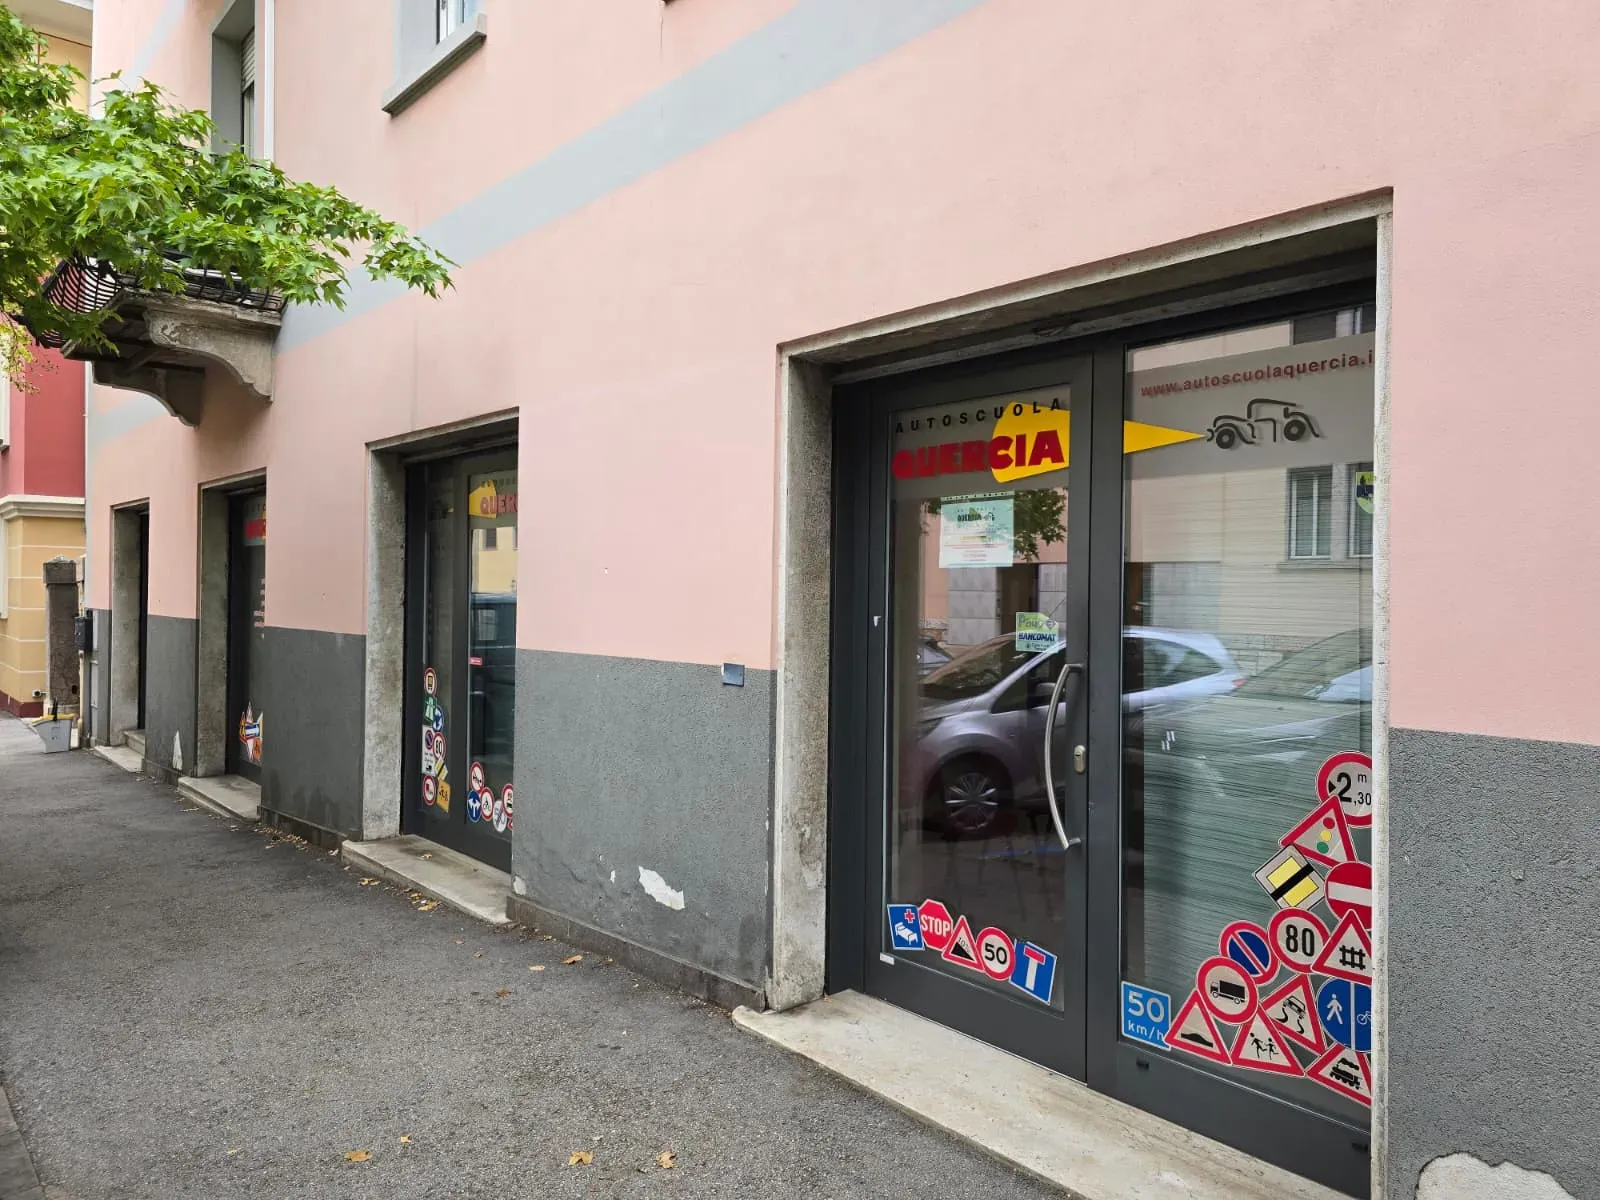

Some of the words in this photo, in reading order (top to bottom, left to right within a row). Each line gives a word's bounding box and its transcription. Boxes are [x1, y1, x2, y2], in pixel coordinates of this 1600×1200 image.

[895, 397, 1062, 433] AUTOSCUOLA
[892, 430, 1064, 479] QUERCIA
[1018, 632, 1057, 642] BANCOMAT
[920, 914, 951, 937] STOP
[984, 942, 1008, 965] 50
[1285, 923, 1316, 958] 80
[1127, 990, 1165, 1023] 50
[1128, 1019, 1164, 1041] km/h
